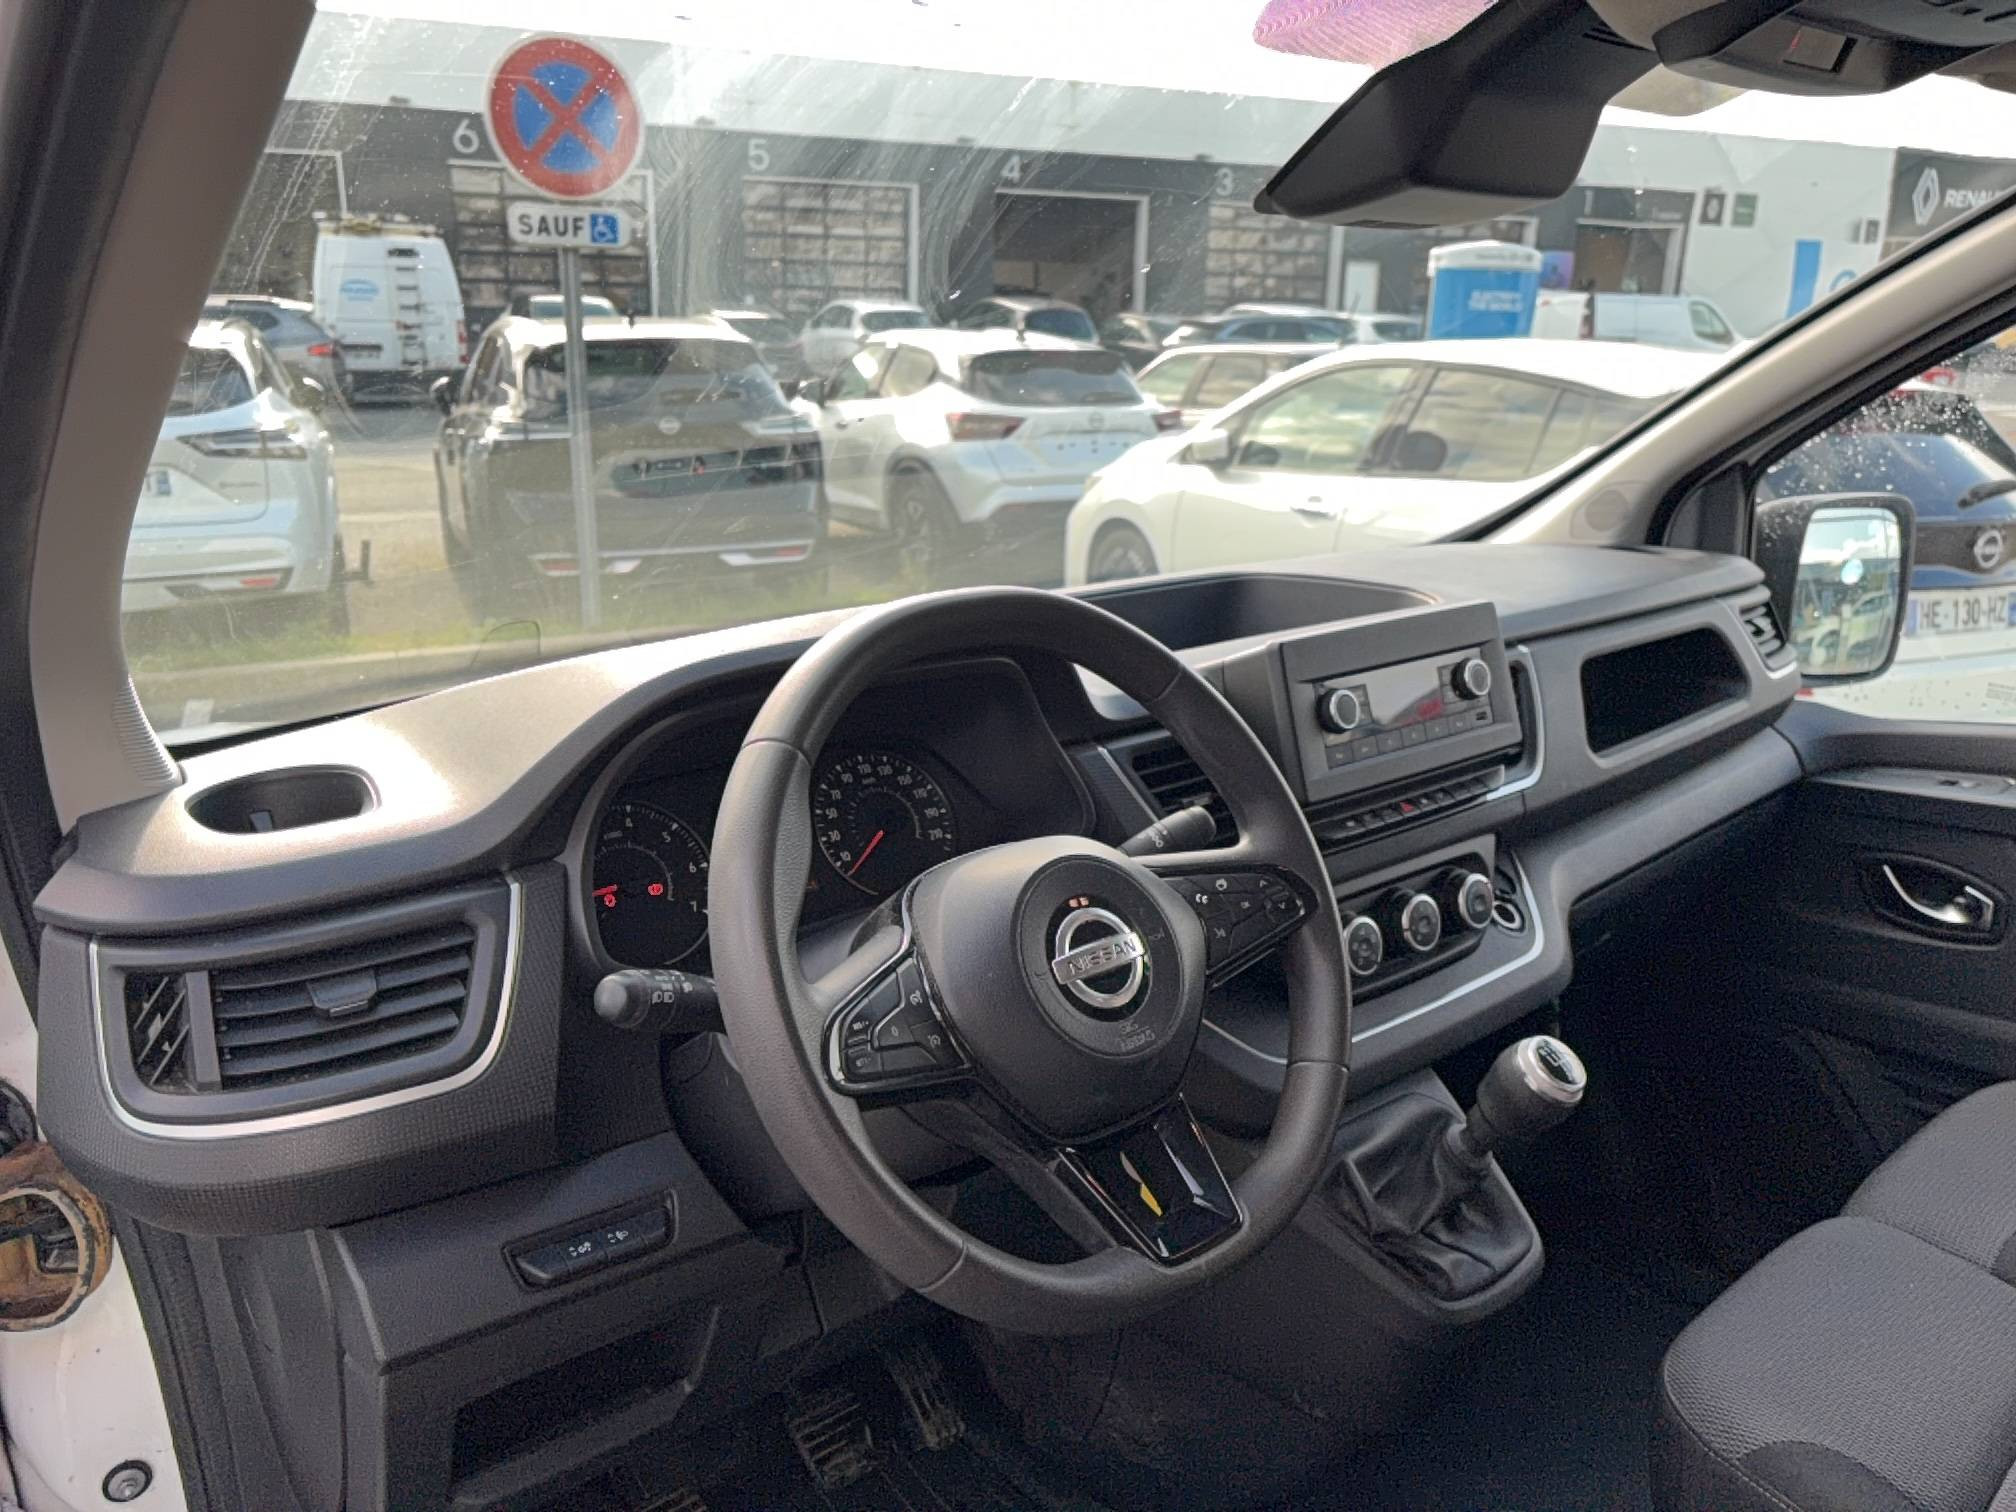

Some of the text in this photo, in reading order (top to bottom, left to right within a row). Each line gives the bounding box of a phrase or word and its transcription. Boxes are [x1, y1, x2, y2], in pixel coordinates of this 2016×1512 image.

[453, 119, 480, 153] 6
[748, 139, 770, 171] 5
[1002, 155, 1022, 183] 4
[1215, 167, 1234, 196] 3
[518, 213, 585, 238] SAUF
[661, 831, 672, 843] 5
[689, 862, 697, 873] 6
[1067, 938, 1137, 975] NISSAN
